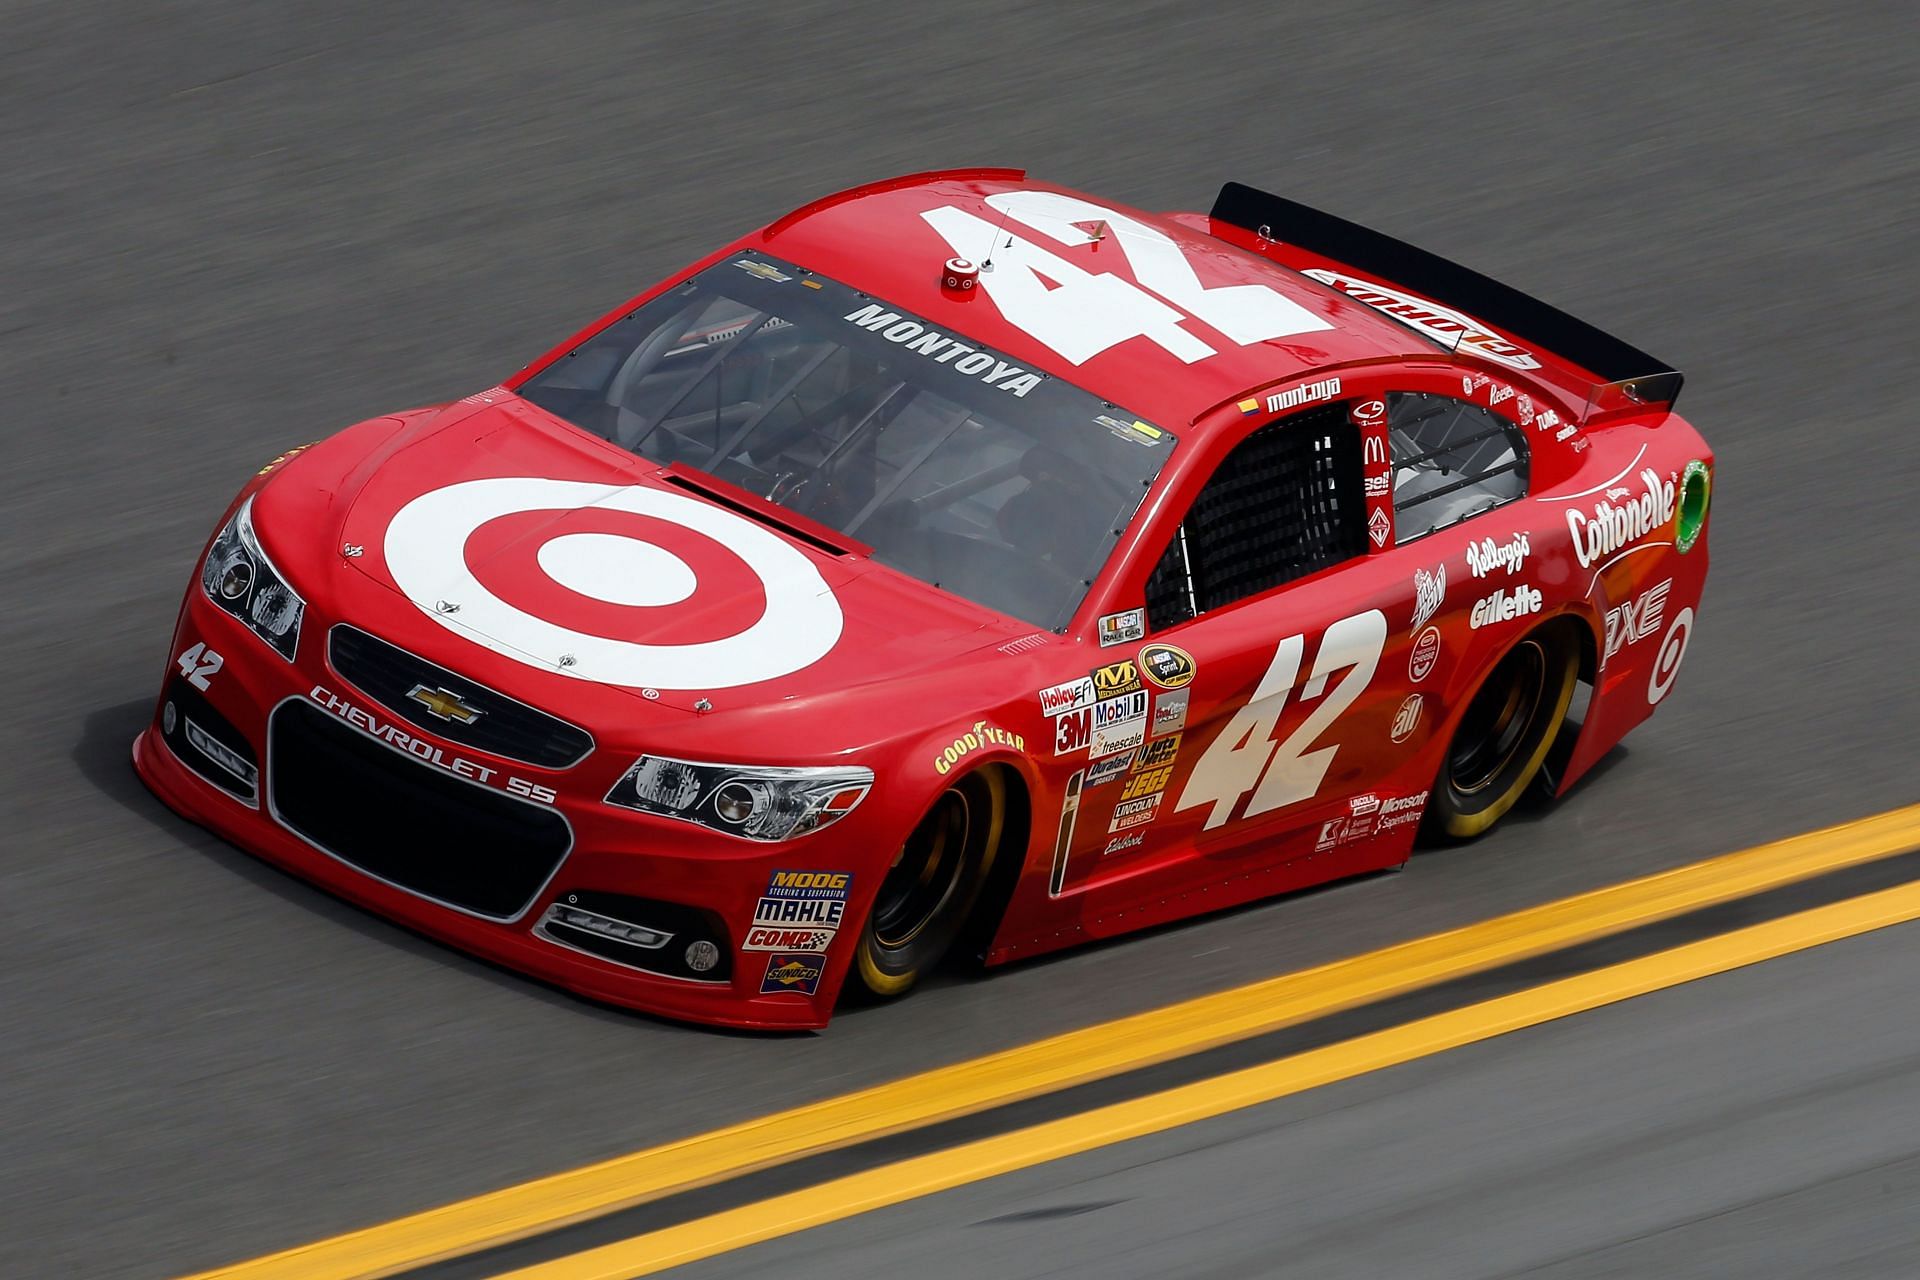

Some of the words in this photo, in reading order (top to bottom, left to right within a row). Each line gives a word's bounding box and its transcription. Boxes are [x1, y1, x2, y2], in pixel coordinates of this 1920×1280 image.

[920, 191, 1337, 366] 42
[844, 303, 1043, 399] MONTOYA
[1266, 377, 1341, 413] montoya
[1566, 467, 1675, 568] Cottonelle
[1466, 531, 1531, 578] Kellogg's
[1469, 583, 1543, 630] Gillette
[177, 641, 224, 692] 42
[1159, 660, 1178, 676] Sprint
[1041, 687, 1076, 710] Holley
[1096, 695, 1130, 725] Mobil
[1058, 708, 1092, 752] 3M
[1174, 608, 1387, 831] 42
[1391, 695, 1423, 738] all
[310, 685, 498, 783] CHEVROLET
[506, 776, 557, 804] SS
[1102, 732, 1142, 754] freescale
[1090, 751, 1133, 776] Duralast
[1121, 766, 1174, 801] JEGS
[1114, 796, 1156, 818] LINCOLN
[1378, 790, 1429, 816] Microsoft
[772, 872, 849, 889] MOOG
[807, 888, 845, 899] SUSPENSION
[756, 899, 844, 923] MAHLE
[749, 929, 813, 947] COMP
[788, 942, 818, 950] CAMS
[768, 966, 818, 980] SUNOCO
